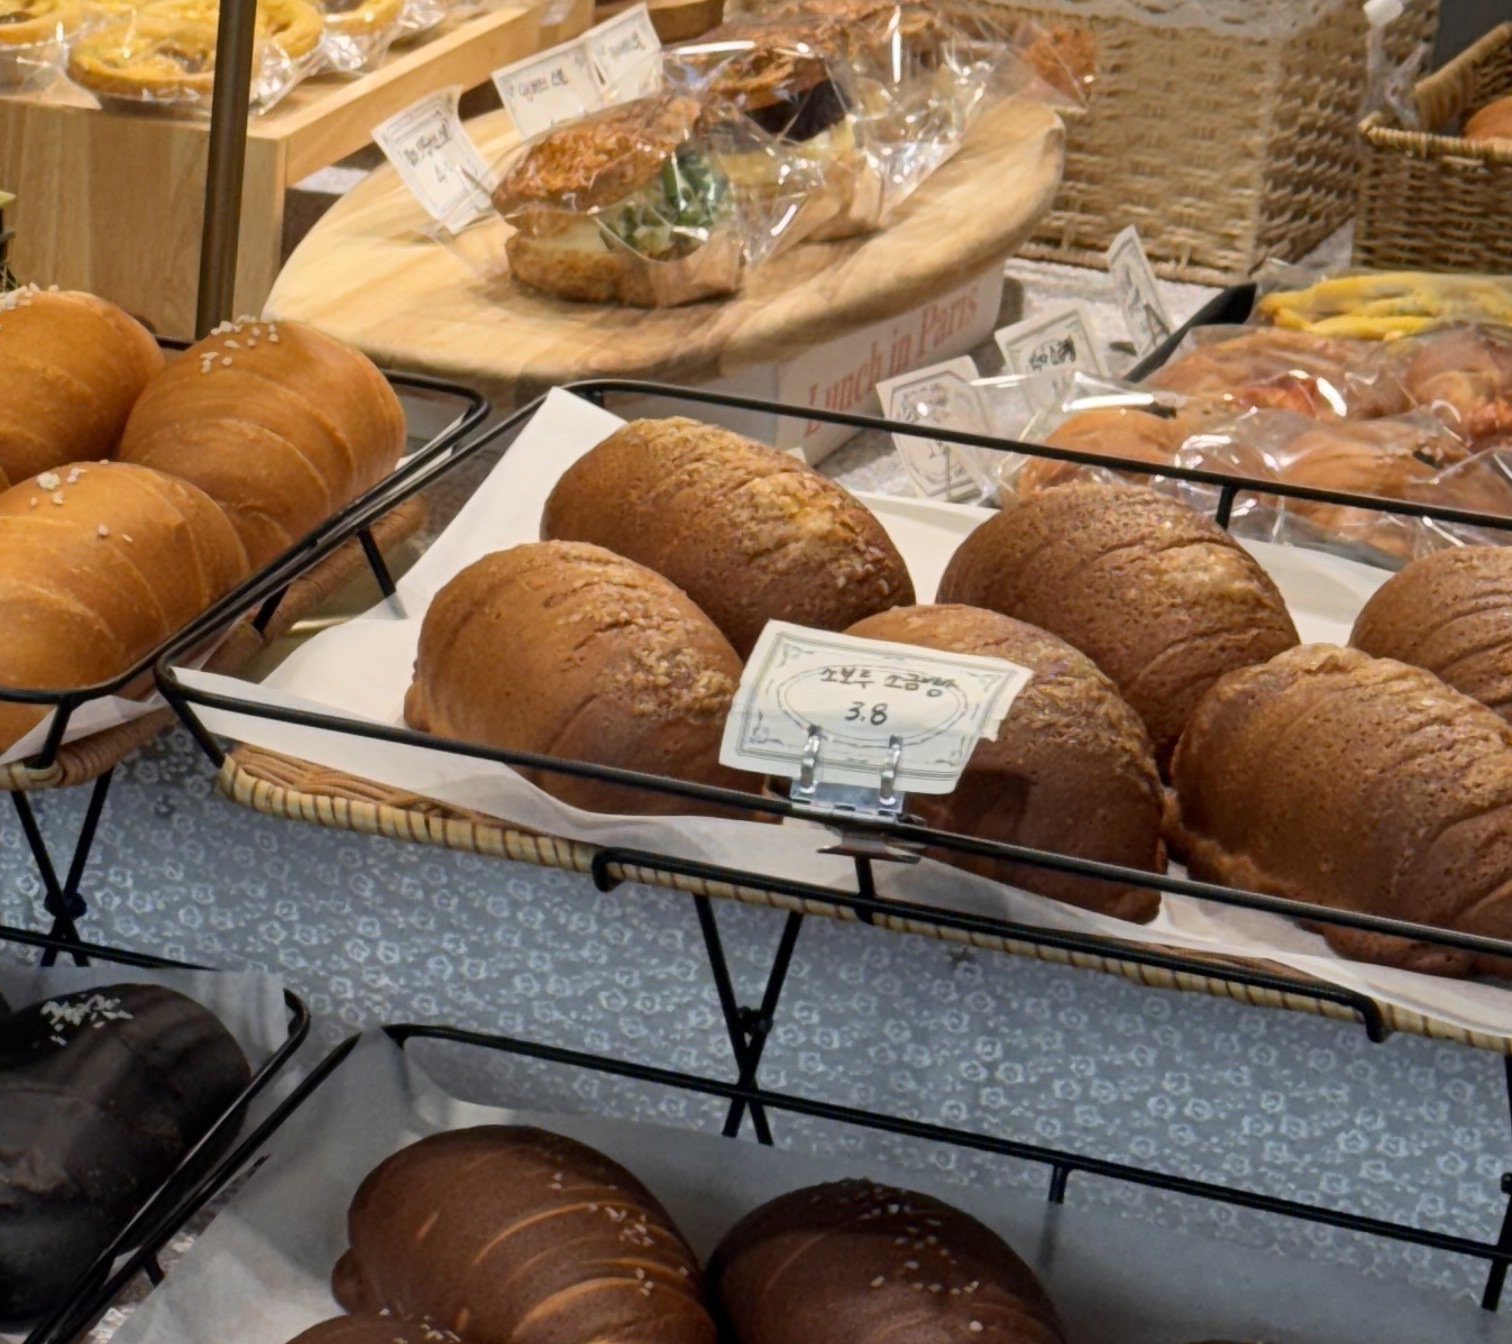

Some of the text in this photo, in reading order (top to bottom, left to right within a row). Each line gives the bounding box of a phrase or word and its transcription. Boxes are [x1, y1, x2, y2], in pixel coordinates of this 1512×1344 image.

[889, 326, 913, 378] in
[917, 286, 978, 358] Paris
[883, 672, 959, 699] 소금빵
[844, 701, 889, 726] 3.8
